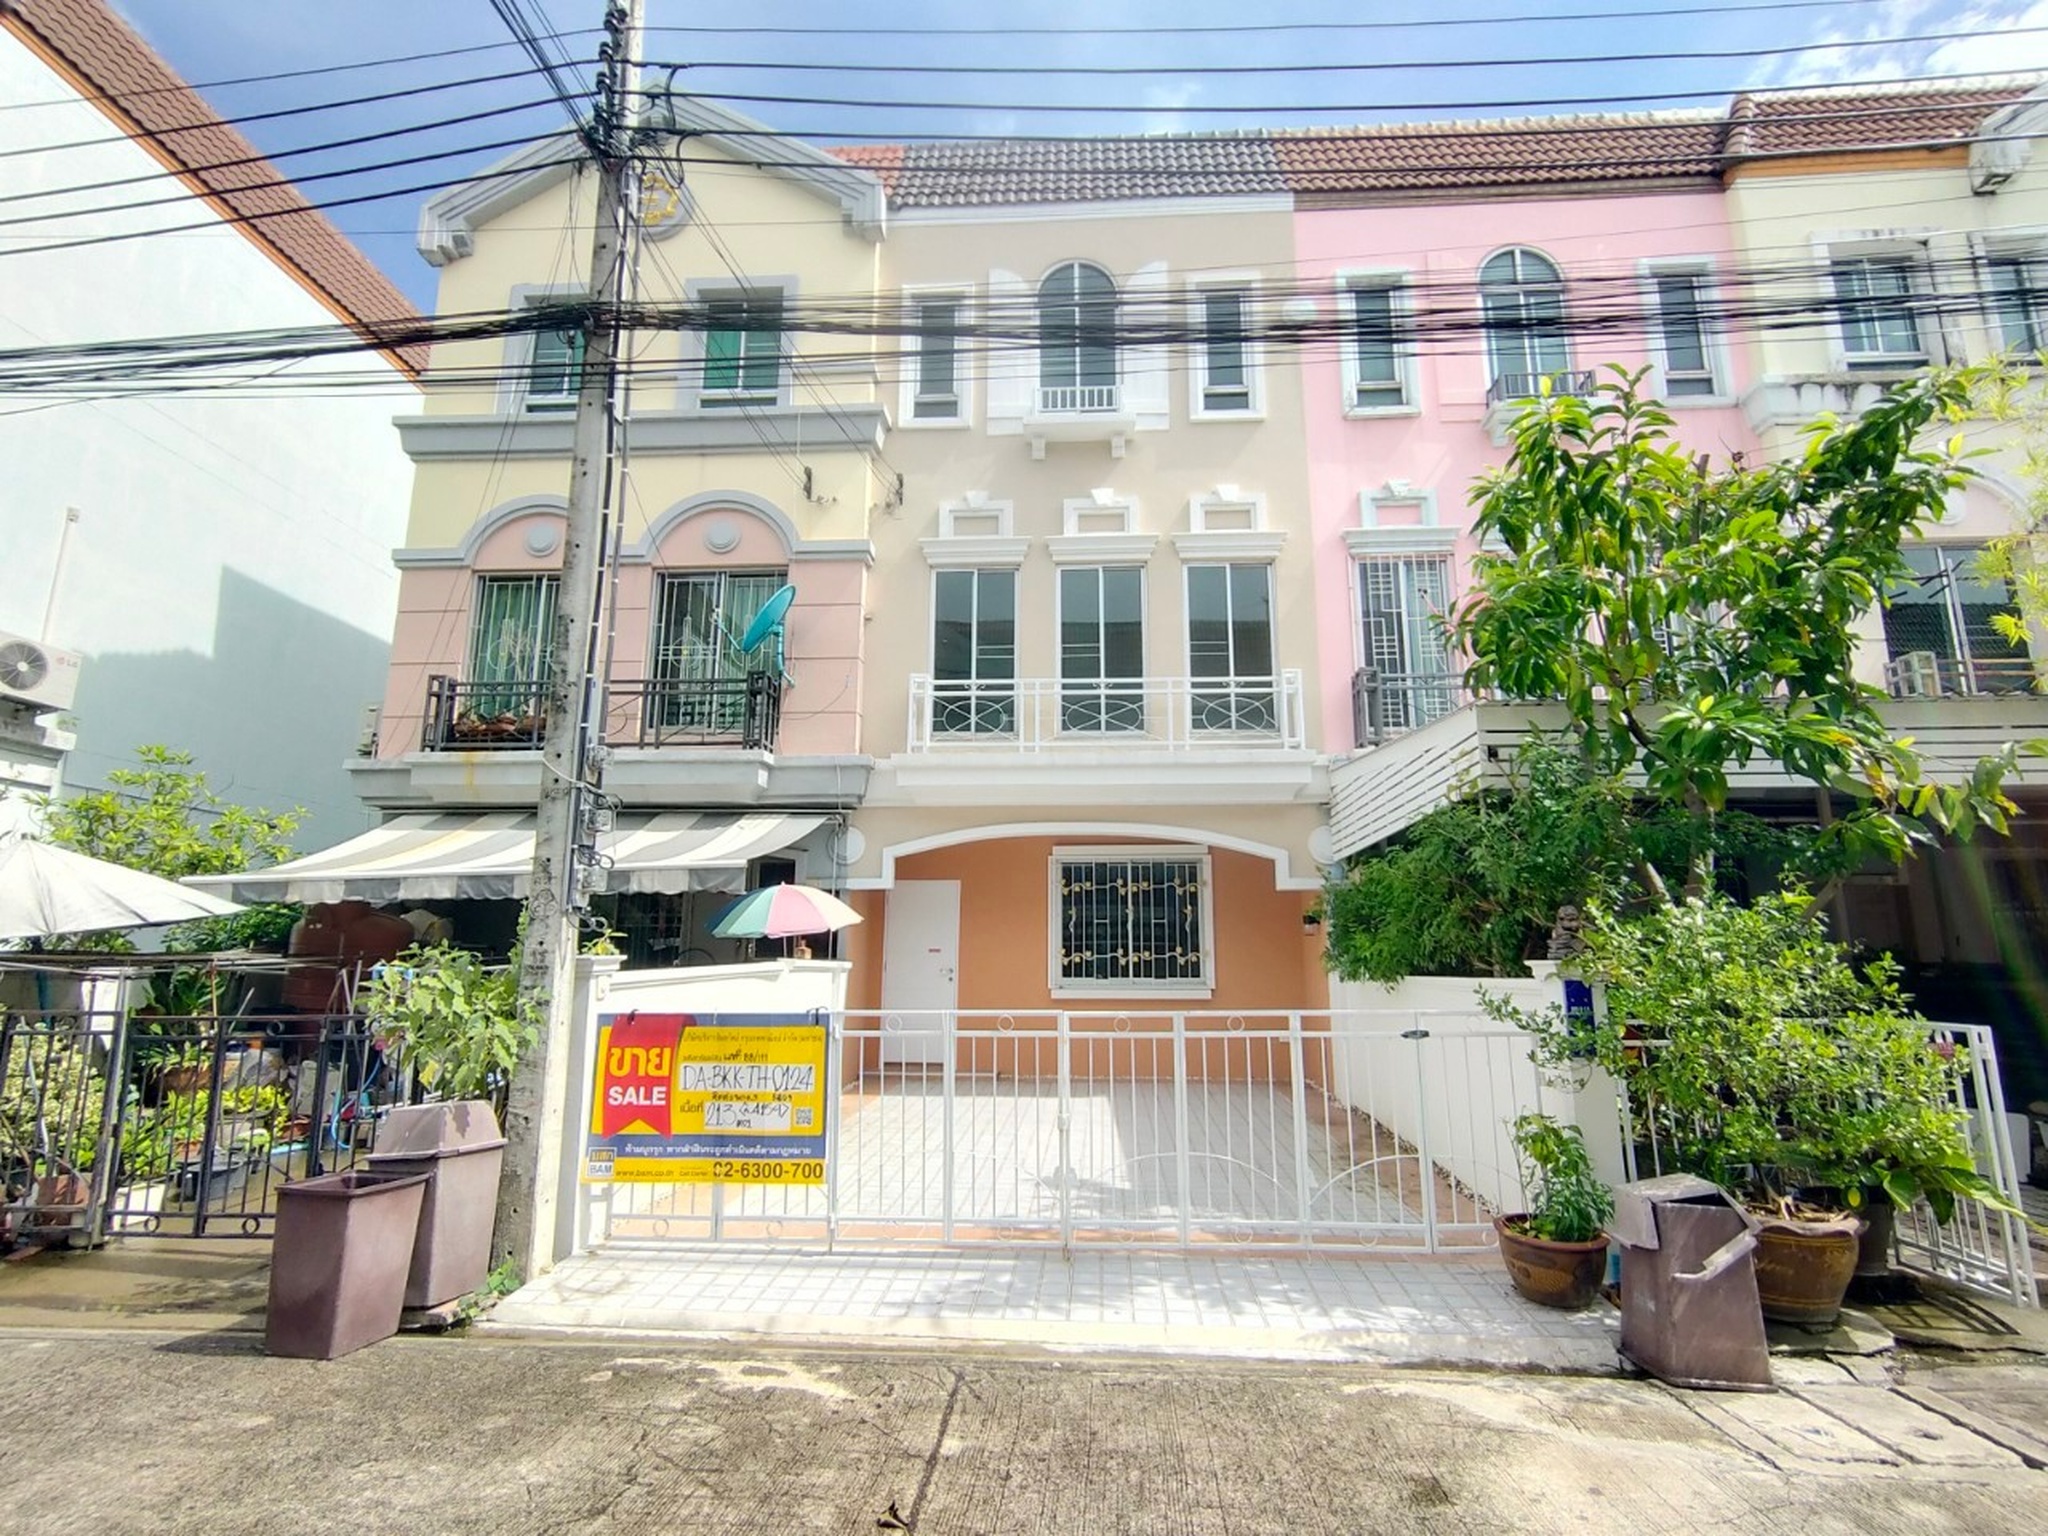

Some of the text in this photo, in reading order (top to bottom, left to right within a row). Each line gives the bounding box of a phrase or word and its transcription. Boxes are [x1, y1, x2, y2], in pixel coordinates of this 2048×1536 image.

[609, 1047, 672, 1077] ขาย
[608, 1085, 667, 1106] SALE
[589, 1164, 612, 1174] BAM
[713, 1161, 823, 1179] 02-6300-700
